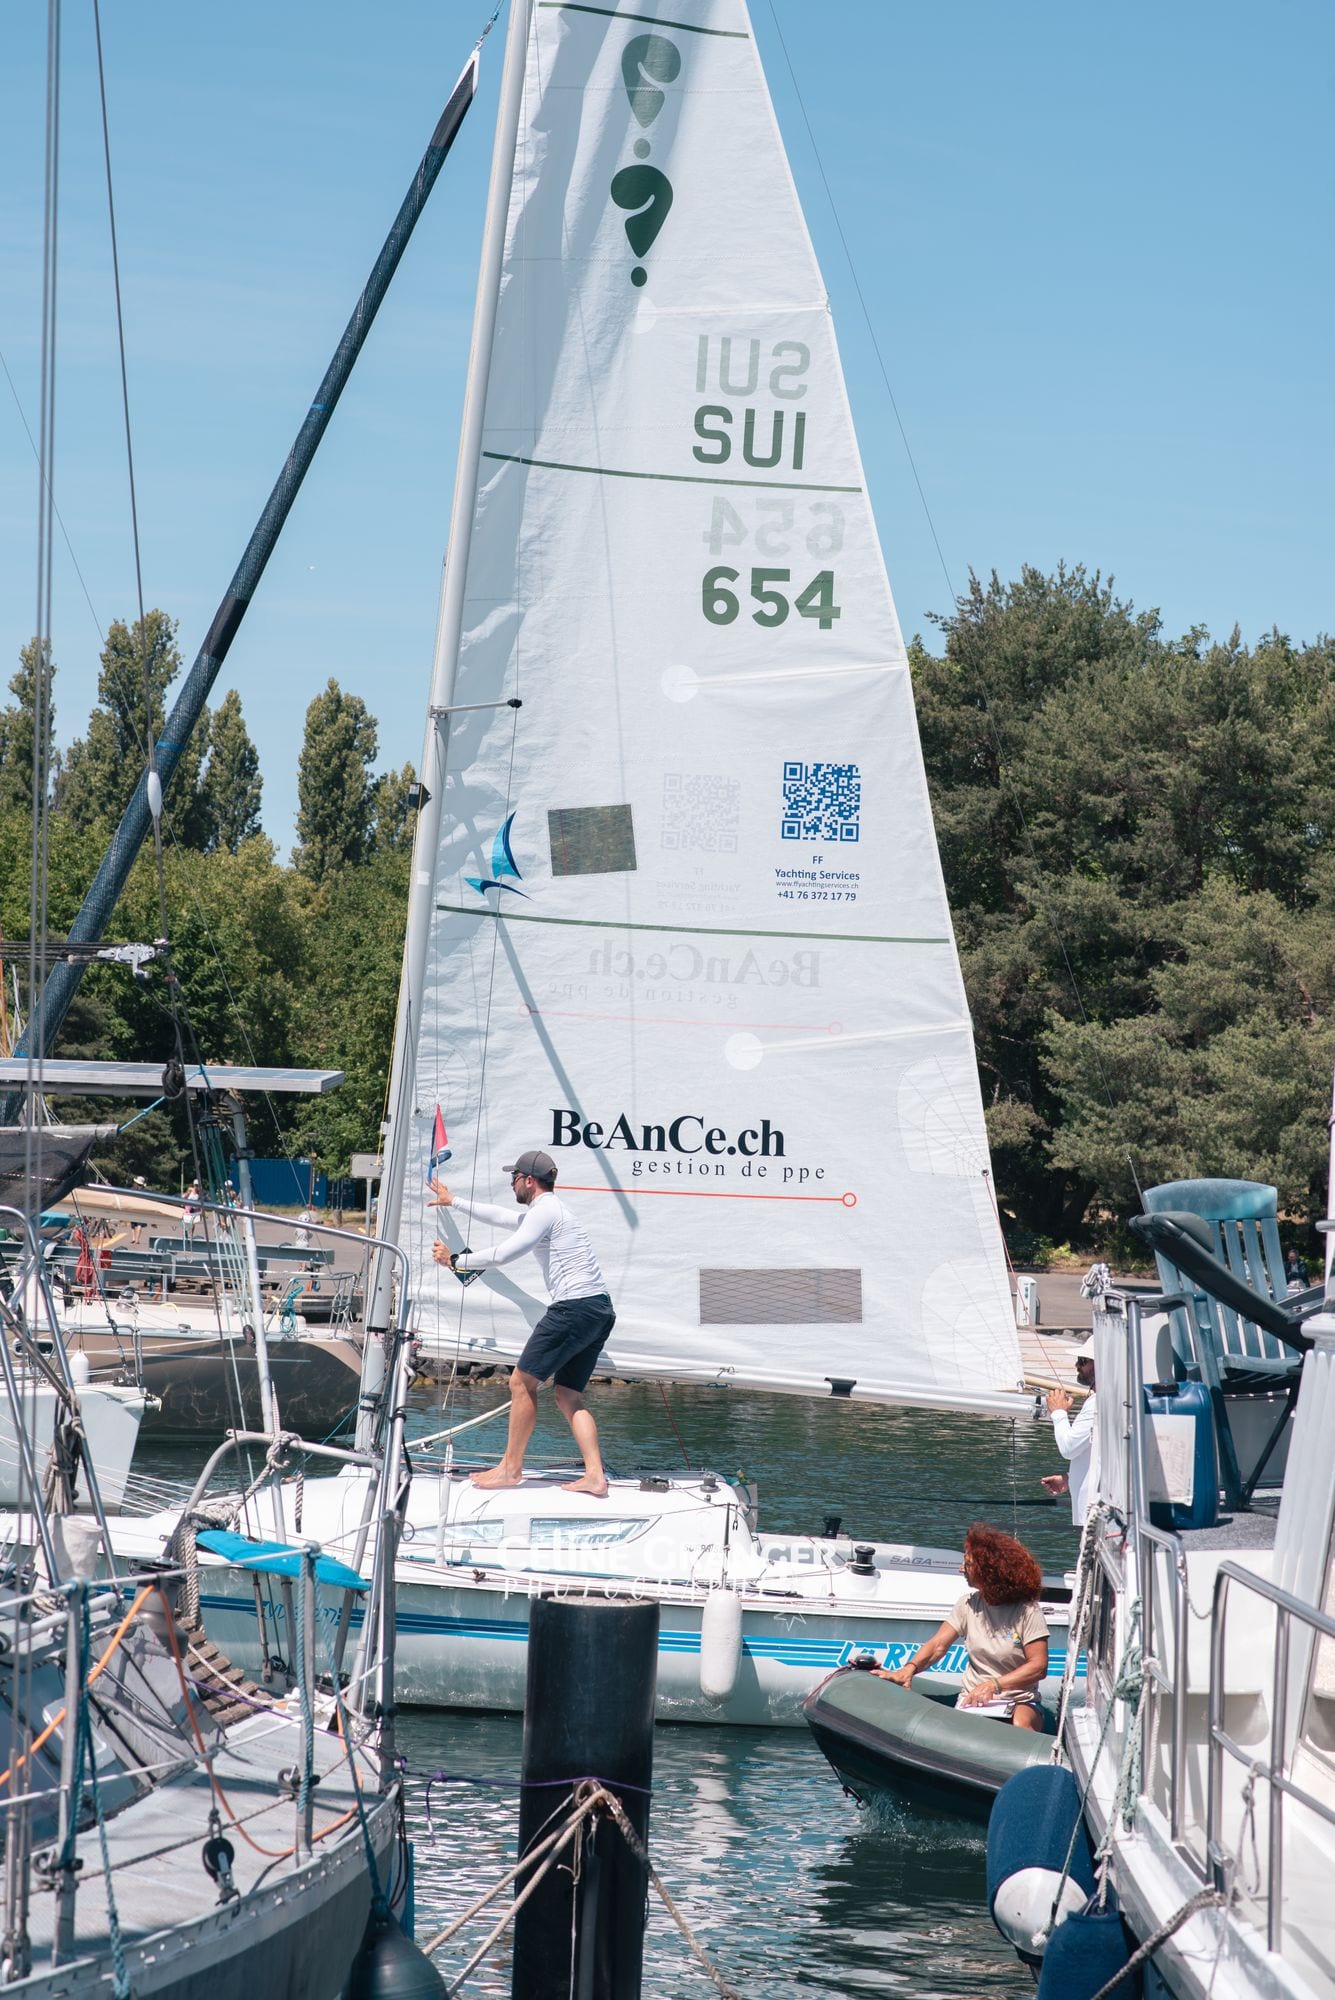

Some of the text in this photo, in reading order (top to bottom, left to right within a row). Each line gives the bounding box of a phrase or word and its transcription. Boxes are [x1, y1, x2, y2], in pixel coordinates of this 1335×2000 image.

[692, 405, 806, 470] SUI
[702, 566, 841, 629] 654
[812, 855, 824, 865] FF
[775, 868, 860, 881] Yachting Services
[775, 880, 859, 889] www.ffyachtingservices.ch
[777, 890, 857, 901] +41 76 372 17 79
[548, 1108, 786, 1157] BeAnCe.ch
[632, 1158, 825, 1183] gestion de ppe
[890, 1555, 932, 1566] SAGA
